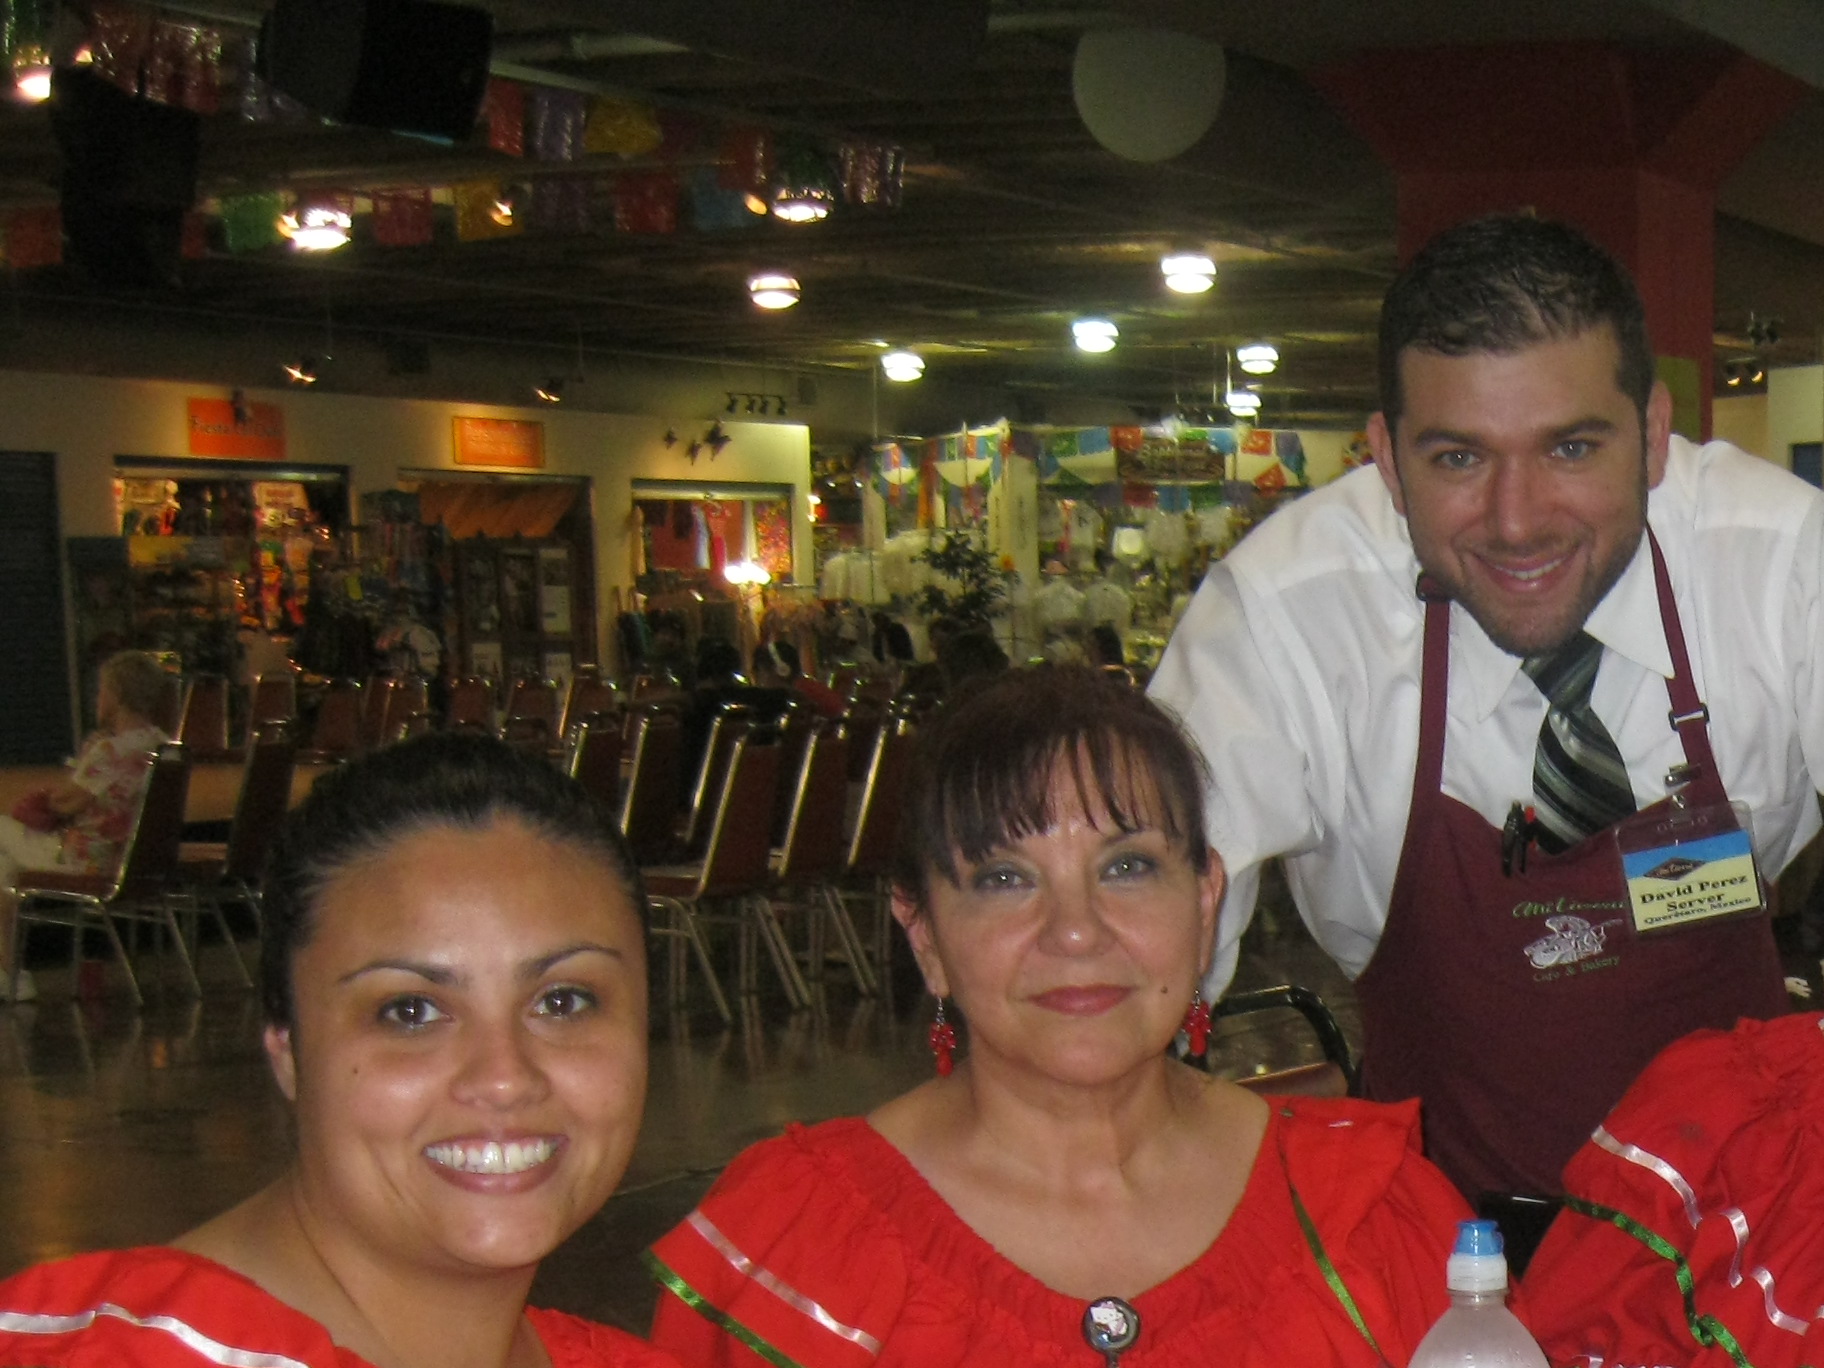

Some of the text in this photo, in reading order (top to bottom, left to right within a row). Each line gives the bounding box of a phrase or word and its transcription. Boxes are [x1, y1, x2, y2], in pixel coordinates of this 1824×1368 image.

[1640, 875, 1748, 904] David Perez
[1666, 893, 1725, 912] Server
